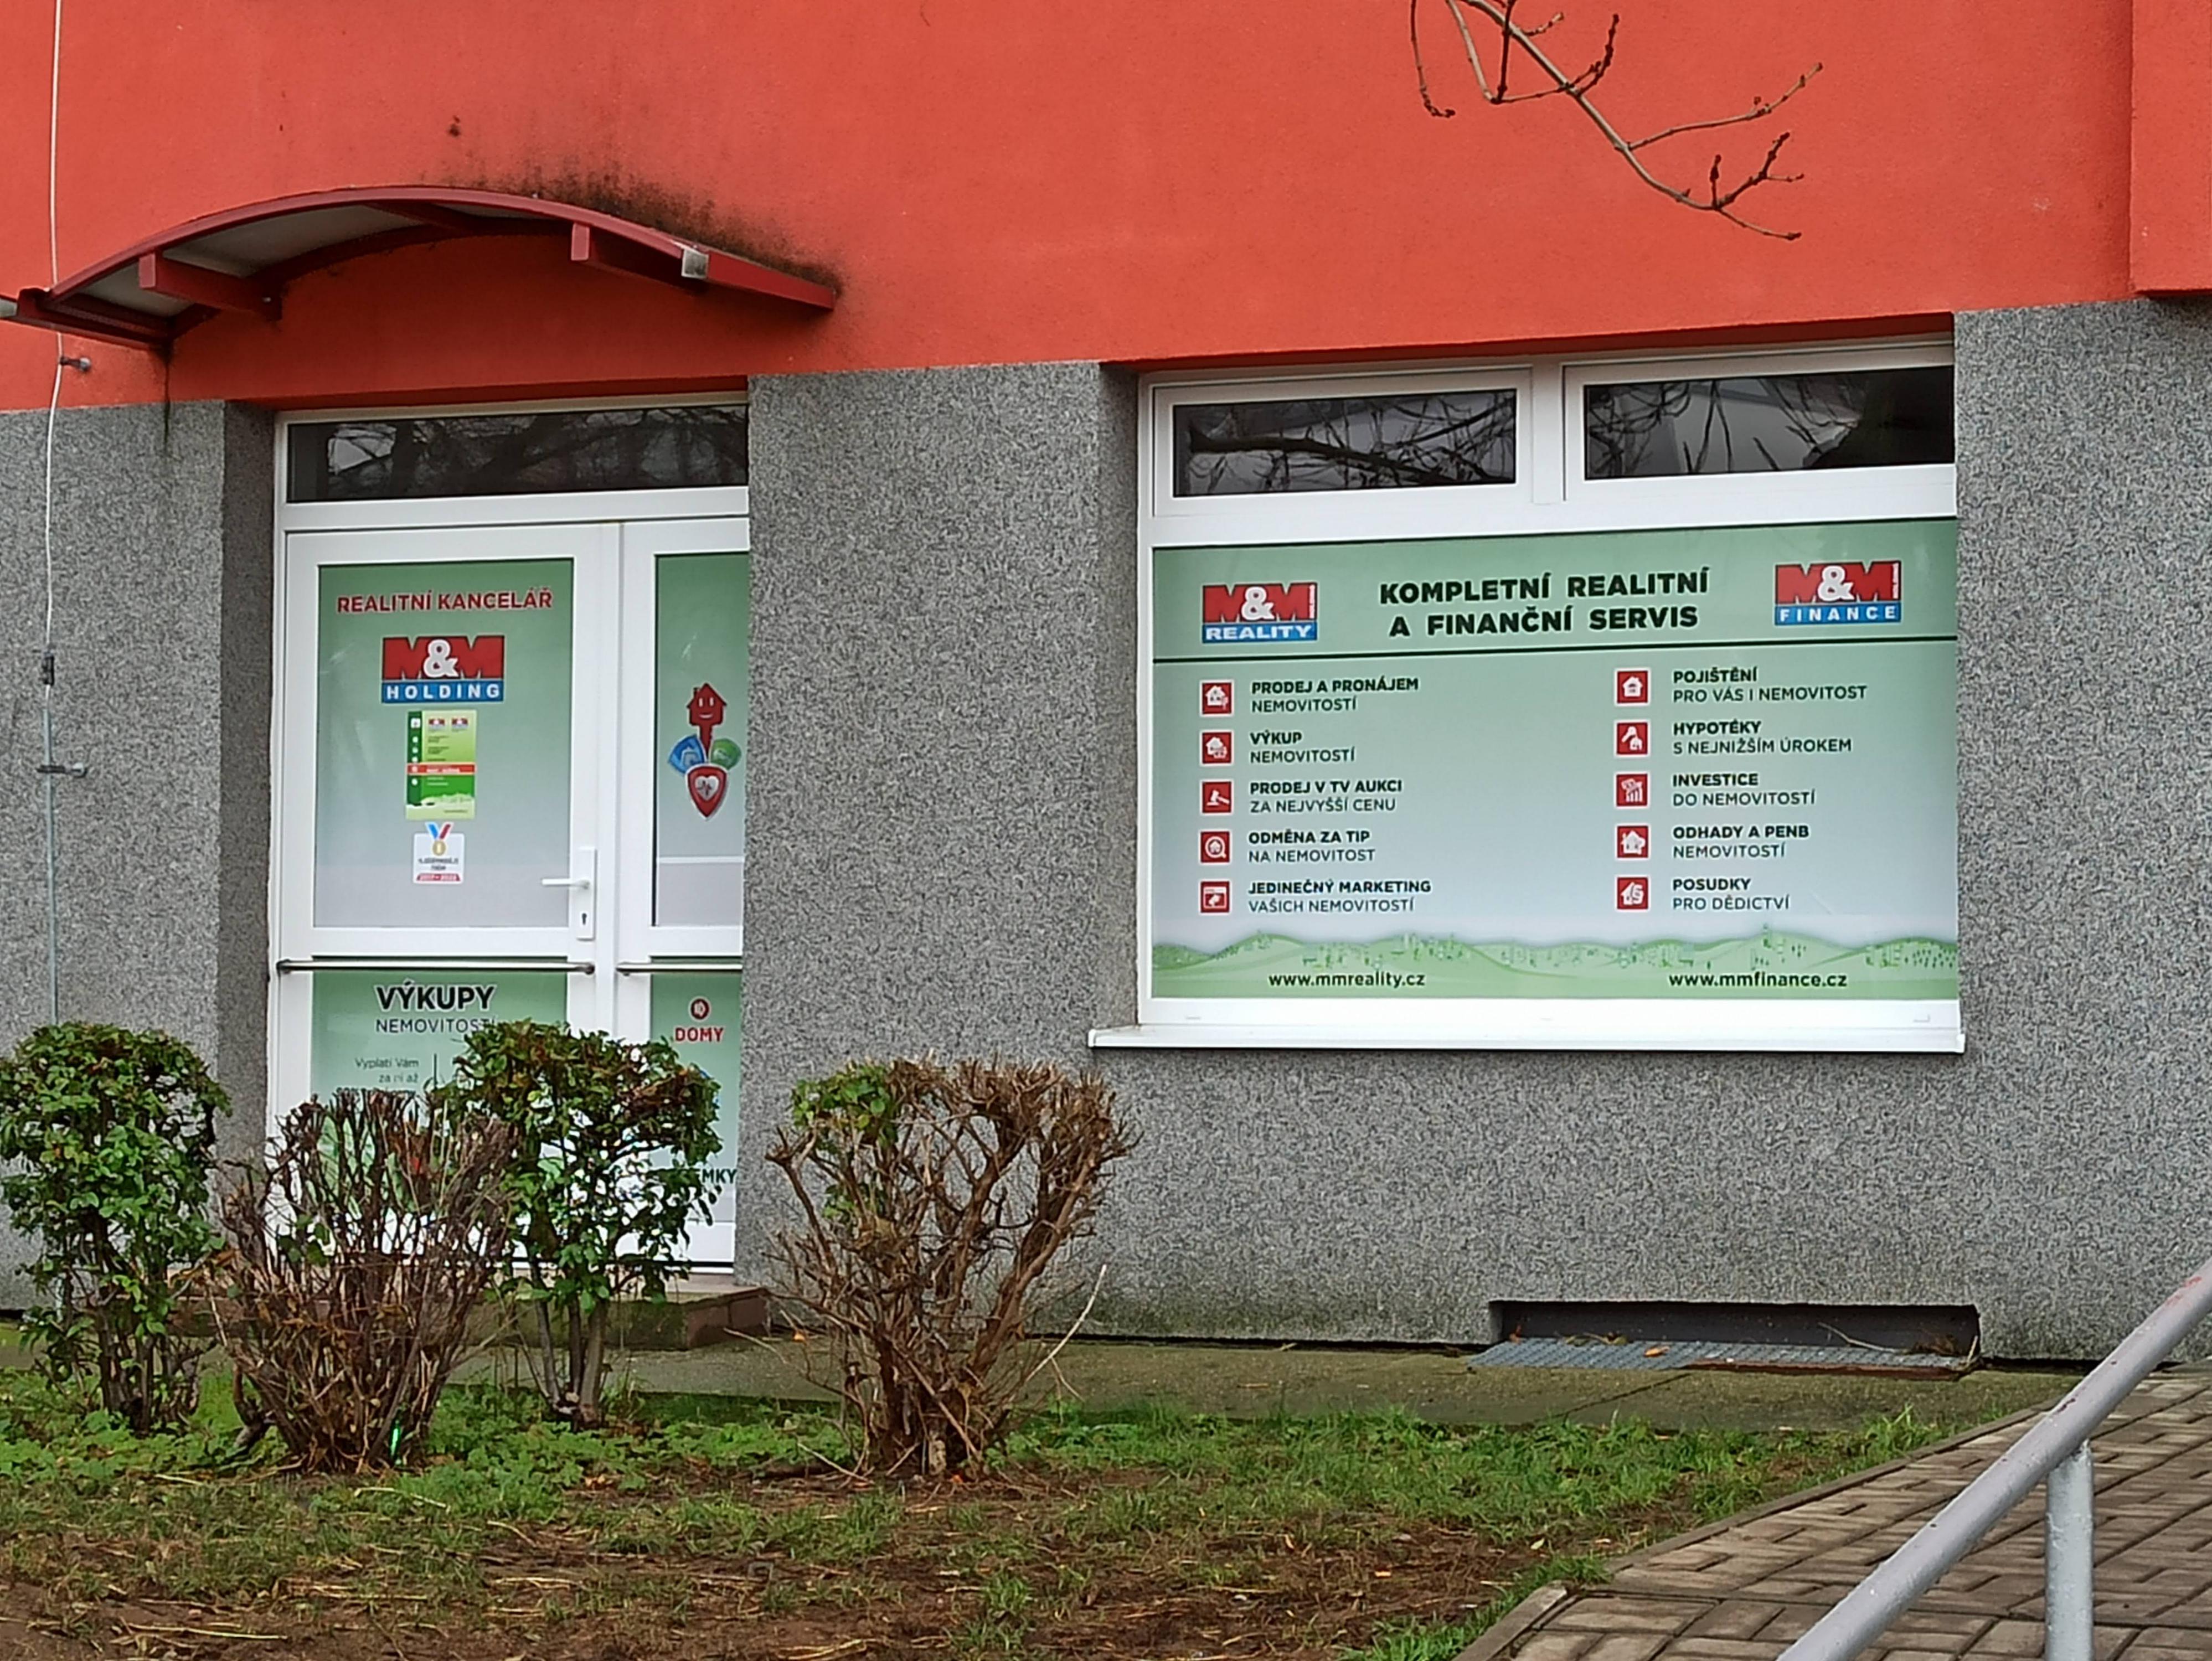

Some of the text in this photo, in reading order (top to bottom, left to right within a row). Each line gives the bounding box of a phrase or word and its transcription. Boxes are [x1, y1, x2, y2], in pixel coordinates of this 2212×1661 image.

[1381, 567, 1709, 604] KOMPLETNÍ REALITNÍ
[1776, 561, 1901, 605] M&M
[338, 587, 553, 613] REALITNÍ KANCELÁŘ
[1203, 582, 1317, 623] M&M
[1390, 605, 1697, 637] A FINANČNÍ SERVIS
[1780, 606, 1895, 622] FINANCE
[1206, 626, 1312, 640] REALITY
[383, 636, 504, 679] M&M
[1674, 666, 1757, 683] POJIŠTĚNÍ
[386, 684, 499, 699] HOLDING
[1252, 675, 1418, 694] PRODEJ A PRONÁJEM
[1674, 685, 1867, 703] PRO VÁS I NEMOVITOST
[1252, 695, 1356, 712] NEMOVITOSTÍ
[1674, 719, 1761, 735] HYPOTÉKY
[1250, 730, 1302, 745] VÝKUP
[1674, 737, 1851, 754] S NEJNIŽŠÍM ÚROKEM
[1251, 746, 1354, 763] NEMOVITOSTÍ
[1251, 780, 1401, 795] PRODEJ V TV AUKCI
[1673, 773, 1758, 787] INVESTICE
[1251, 797, 1395, 813] ZA NEJVYŠŠÍ CENU
[1673, 789, 1815, 806] DO NEMOVITOSTÍ
[1249, 829, 1369, 844] ODMĚNA ZA TIP
[1673, 826, 1809, 839] ODHADY A PENB
[1249, 849, 1375, 862] NA NEMOVITOST
[1674, 842, 1785, 858] NEMOVITOSTÍ
[1249, 879, 1431, 894] JEDINEČNÝ MARKETING
[1673, 878, 1751, 890] POSUDKY
[1249, 896, 1414, 912] VAŠICH NEMOVITOSTÍ
[1673, 894, 1789, 910] PRO DĚDICTVÍ
[1269, 969, 1425, 988] www.mmreality.cz
[1669, 972, 1847, 987] www.mmfinance.cz
[377, 981, 495, 1009] VÝKUPY
[675, 1027, 724, 1043] DOMY
